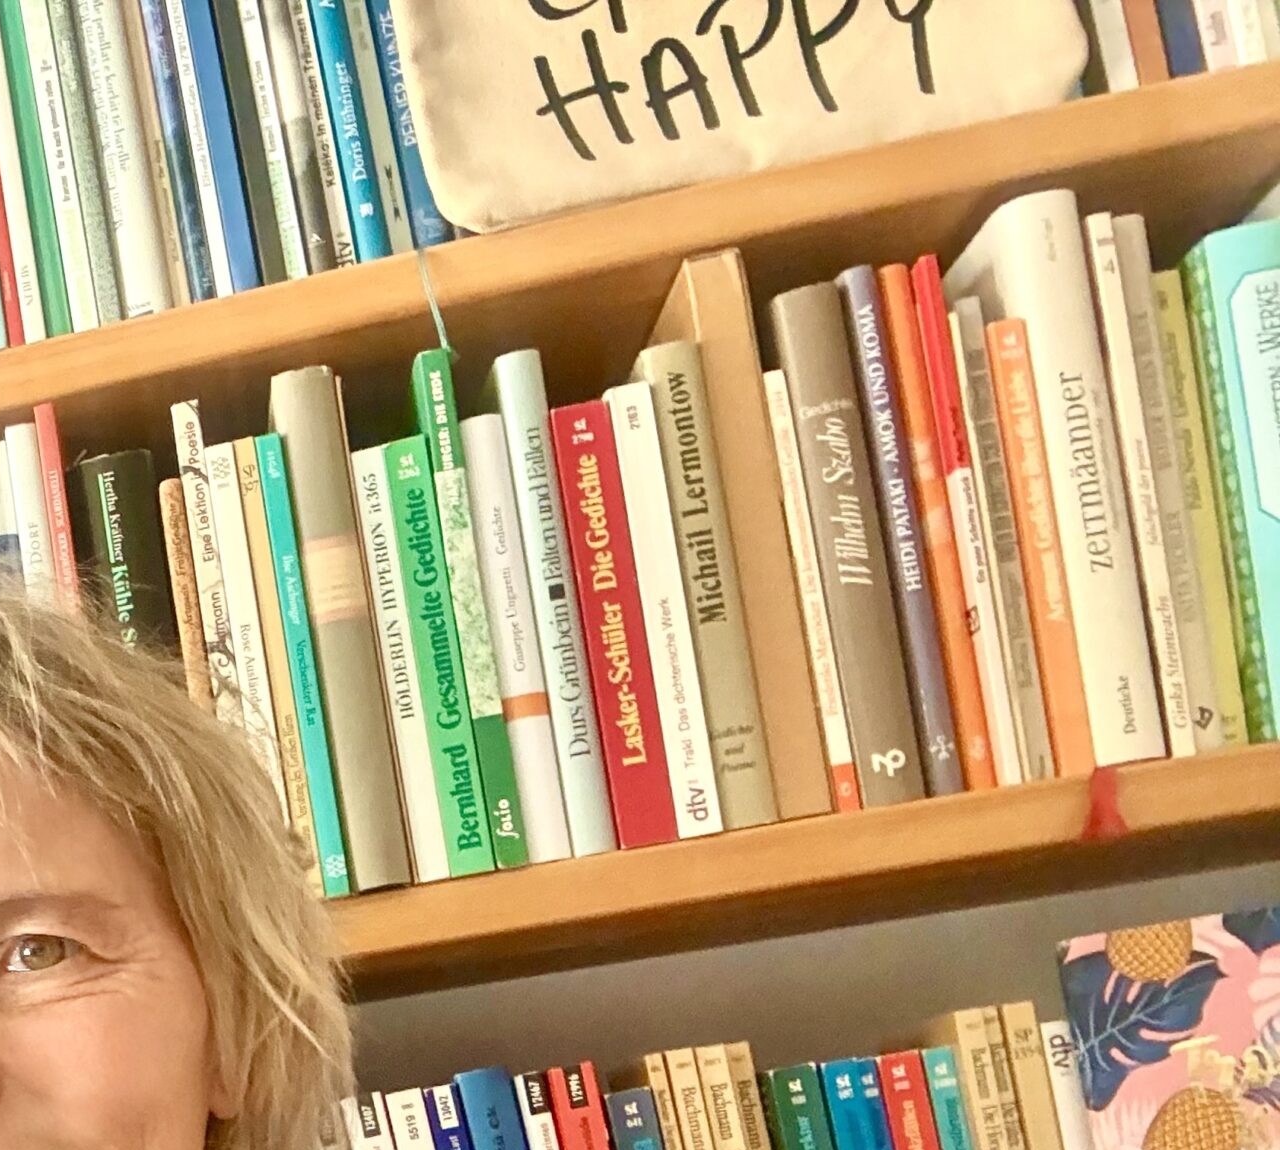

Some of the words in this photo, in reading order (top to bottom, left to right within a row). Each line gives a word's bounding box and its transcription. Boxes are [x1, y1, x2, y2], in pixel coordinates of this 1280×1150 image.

[329, 60, 361, 139] Mühringer
[534, 0, 937, 160] HAPPY
[345, 141, 367, 182] Doris
[855, 302, 880, 359] KOMA
[427, 369, 445, 402] ERDE
[867, 361, 889, 404] UND
[433, 402, 449, 425] DIE
[626, 405, 641, 431] 2163
[875, 407, 899, 464] AMOK
[182, 419, 200, 464] Poesie
[522, 425, 547, 480] Fallen
[664, 370, 708, 518] Lermontow
[812, 415, 855, 488] Szabo
[101, 470, 118, 512] Hertha
[193, 482, 210, 530] Lektion
[529, 483, 554, 523] und
[574, 452, 610, 549] Gedichte
[887, 477, 912, 537] PATAKI
[106, 512, 126, 562] Kräftner
[200, 532, 215, 562] Eine
[401, 487, 440, 589] Gedichte
[490, 505, 509, 555] Gedichte
[537, 525, 563, 581] Falten
[827, 490, 872, 589] Wilhelm
[370, 521, 397, 610] HYPERION
[500, 565, 518, 618] Ungaretti
[588, 549, 617, 591] Die
[685, 527, 726, 624] Michail
[899, 540, 922, 591] HEIDI
[111, 564, 134, 623] Kühle
[657, 597, 674, 631] Werk
[239, 623, 252, 653] Rose
[418, 590, 463, 730] Gesammelte
[509, 620, 527, 672] Giuseppe
[548, 602, 582, 702] Grünbein
[384, 618, 414, 719] HÖLDERLIN
[599, 601, 646, 766] Lasker-Schüler
[663, 632, 686, 705] dichterische
[565, 705, 591, 759] Durs
[676, 706, 690, 732] Das
[441, 742, 483, 851] Bernhard
[684, 785, 708, 822] dtv
[1048, 1032, 1076, 1070] dtv
[437, 1094, 453, 1121] 13042
[527, 1080, 544, 1108] 12467
[567, 1072, 583, 1102] 12996
[710, 1081, 735, 1141] Bachmann
[405, 1113, 419, 1141] 5519
[737, 1078, 763, 1150] Bachmann
